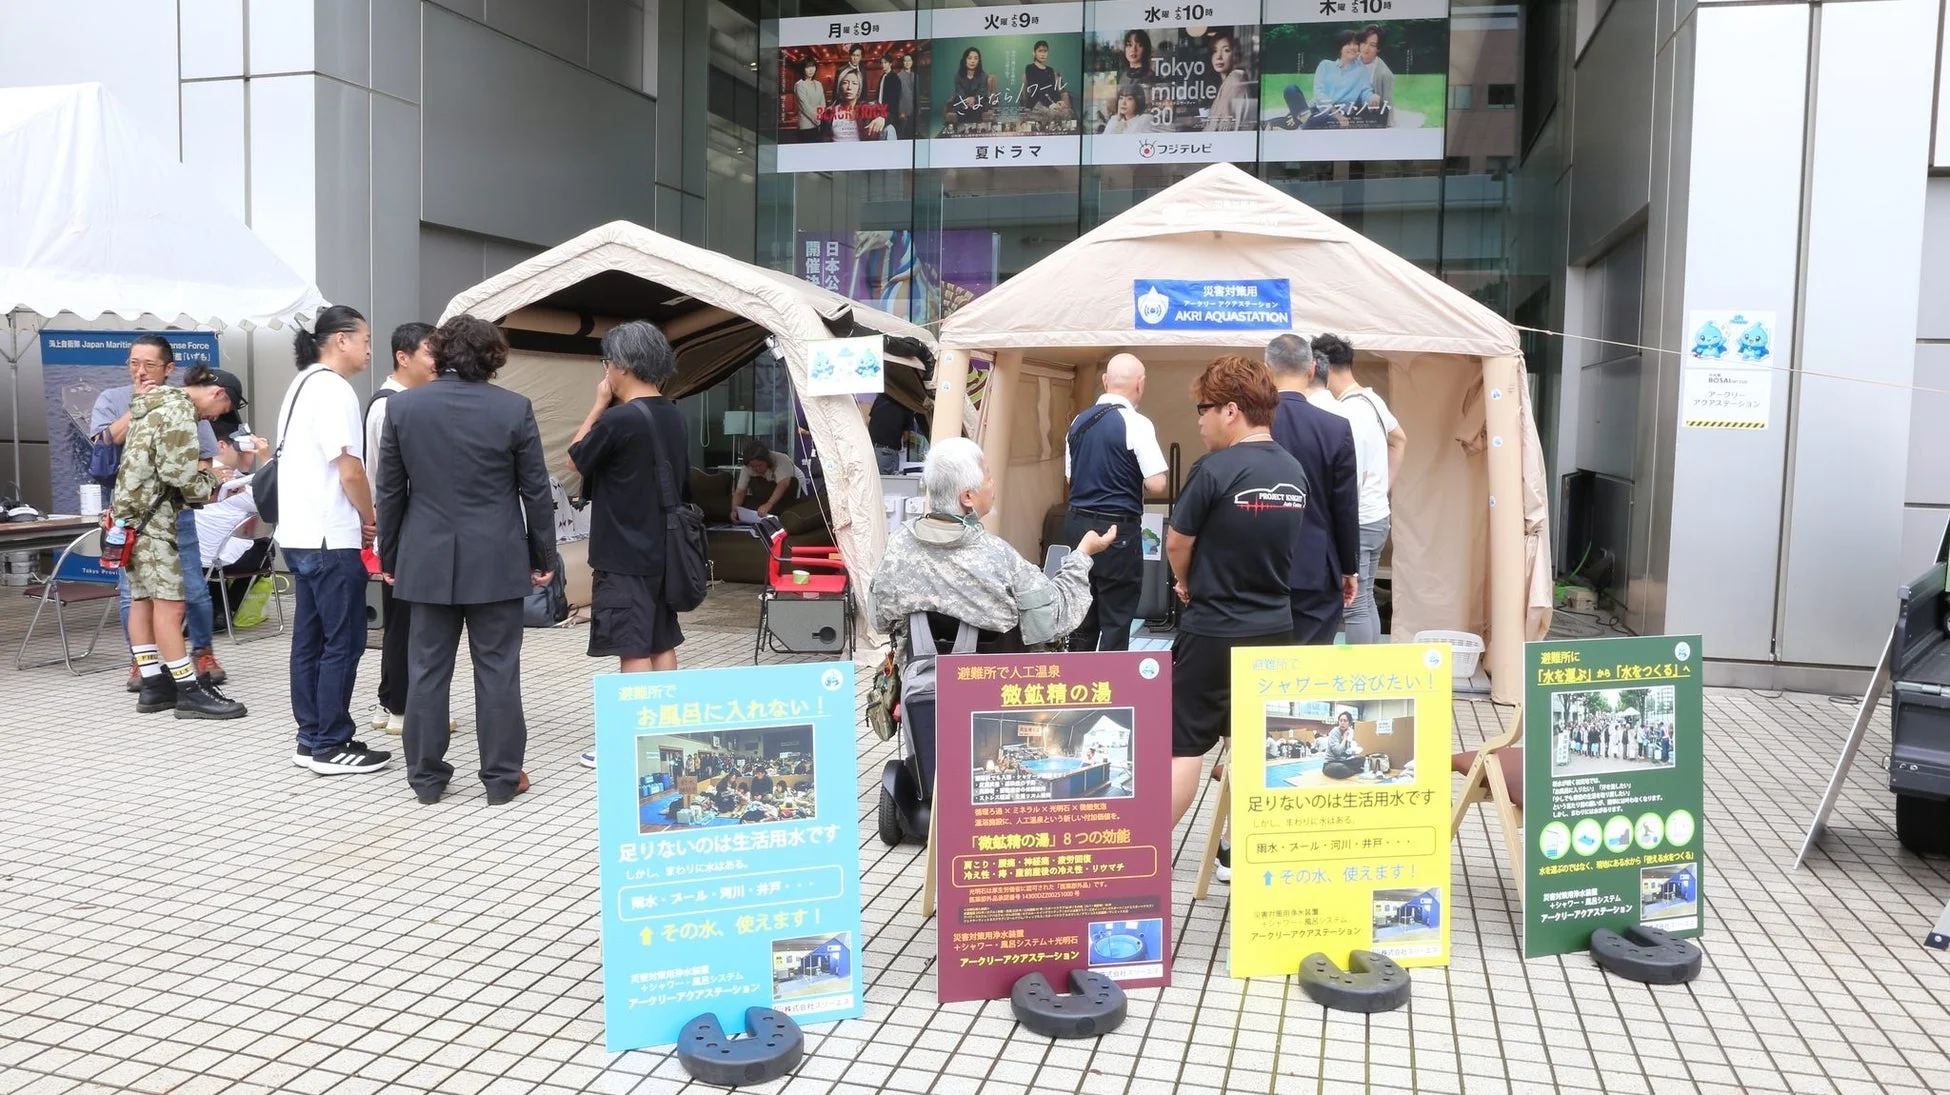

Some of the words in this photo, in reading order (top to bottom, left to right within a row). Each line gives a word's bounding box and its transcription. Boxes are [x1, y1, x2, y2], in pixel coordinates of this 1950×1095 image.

[1151, 57, 1205, 80] Tokyo
[1151, 80, 1217, 100] middle
[1151, 107, 1173, 126] 30
[1314, 100, 1392, 118] ラストノート
[975, 145, 1042, 160] 夏ドラマ
[1157, 142, 1212, 154] フジテレビ
[1203, 285, 1258, 298] 災害対策用
[1175, 310, 1202, 322] AKRI
[1204, 310, 1289, 323] AQUASTATION
[82, 341, 105, 350] Japan
[188, 342, 210, 350] Force
[1258, 493, 1285, 501] PROJECT
[82, 567, 99, 575] Tokyo
[1540, 651, 1581, 665] 避難所に
[957, 665, 1061, 681] 避難所で人工温泉
[618, 685, 677, 701] 避難所で
[1001, 681, 1112, 705] 微鉱精の湯
[1247, 789, 1435, 813] 足りないのは生活用水です
[618, 824, 841, 864] 足りないのは生活用水です
[1541, 904, 1633, 923] アークリーアクアステーション
[953, 929, 1025, 943] 災害対策用浄水装置
[1251, 927, 1361, 941] アークリーアクアステーション
[960, 950, 1080, 968] アークリーアクアステーション
[627, 983, 760, 1010] アークリーアクアステーション
